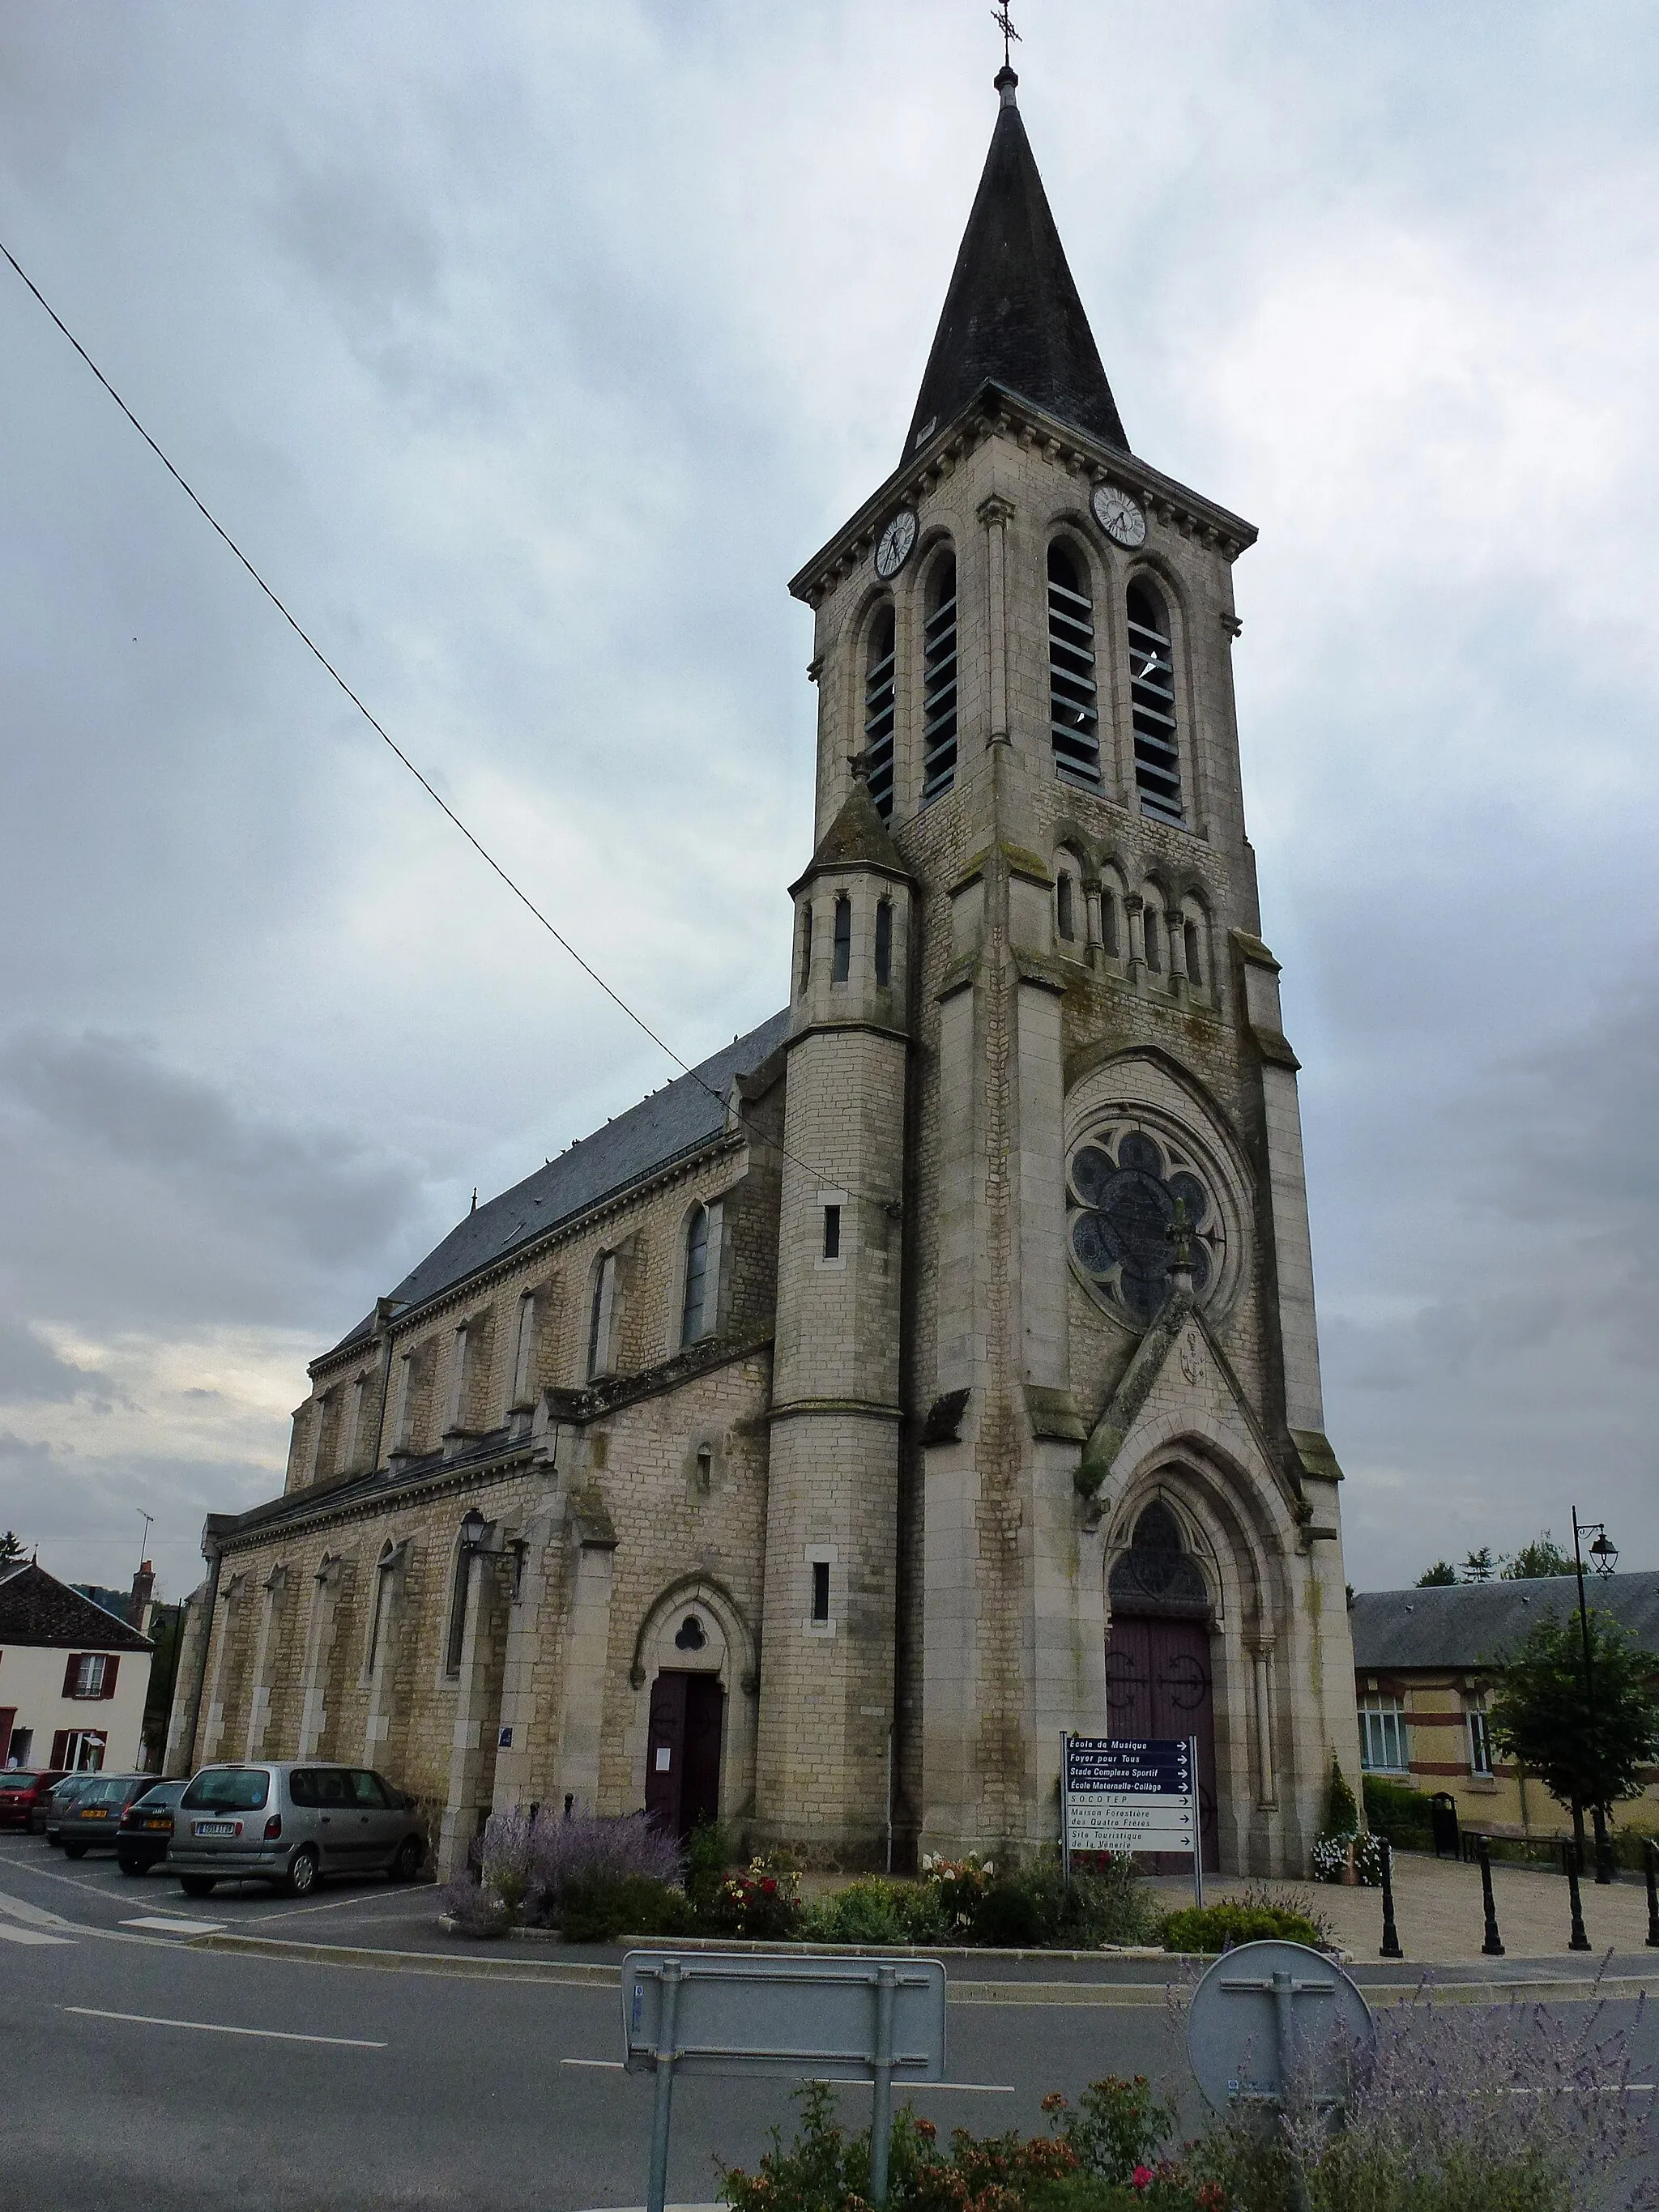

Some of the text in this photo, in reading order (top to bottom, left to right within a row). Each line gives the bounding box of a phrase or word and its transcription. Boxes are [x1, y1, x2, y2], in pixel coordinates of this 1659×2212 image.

[1070, 1738, 1092, 1748] École
[1111, 1741, 1147, 1750] Musique
[1070, 1754, 1094, 1762] Foyer
[1122, 1754, 1141, 1762] Tous
[1071, 1768, 1158, 1777] Stade Complexe Sportif
[1071, 1779, 1090, 1788] École
[1106, 1809, 1149, 1818] Forestière
[1095, 1831, 1141, 1840] Touristique
